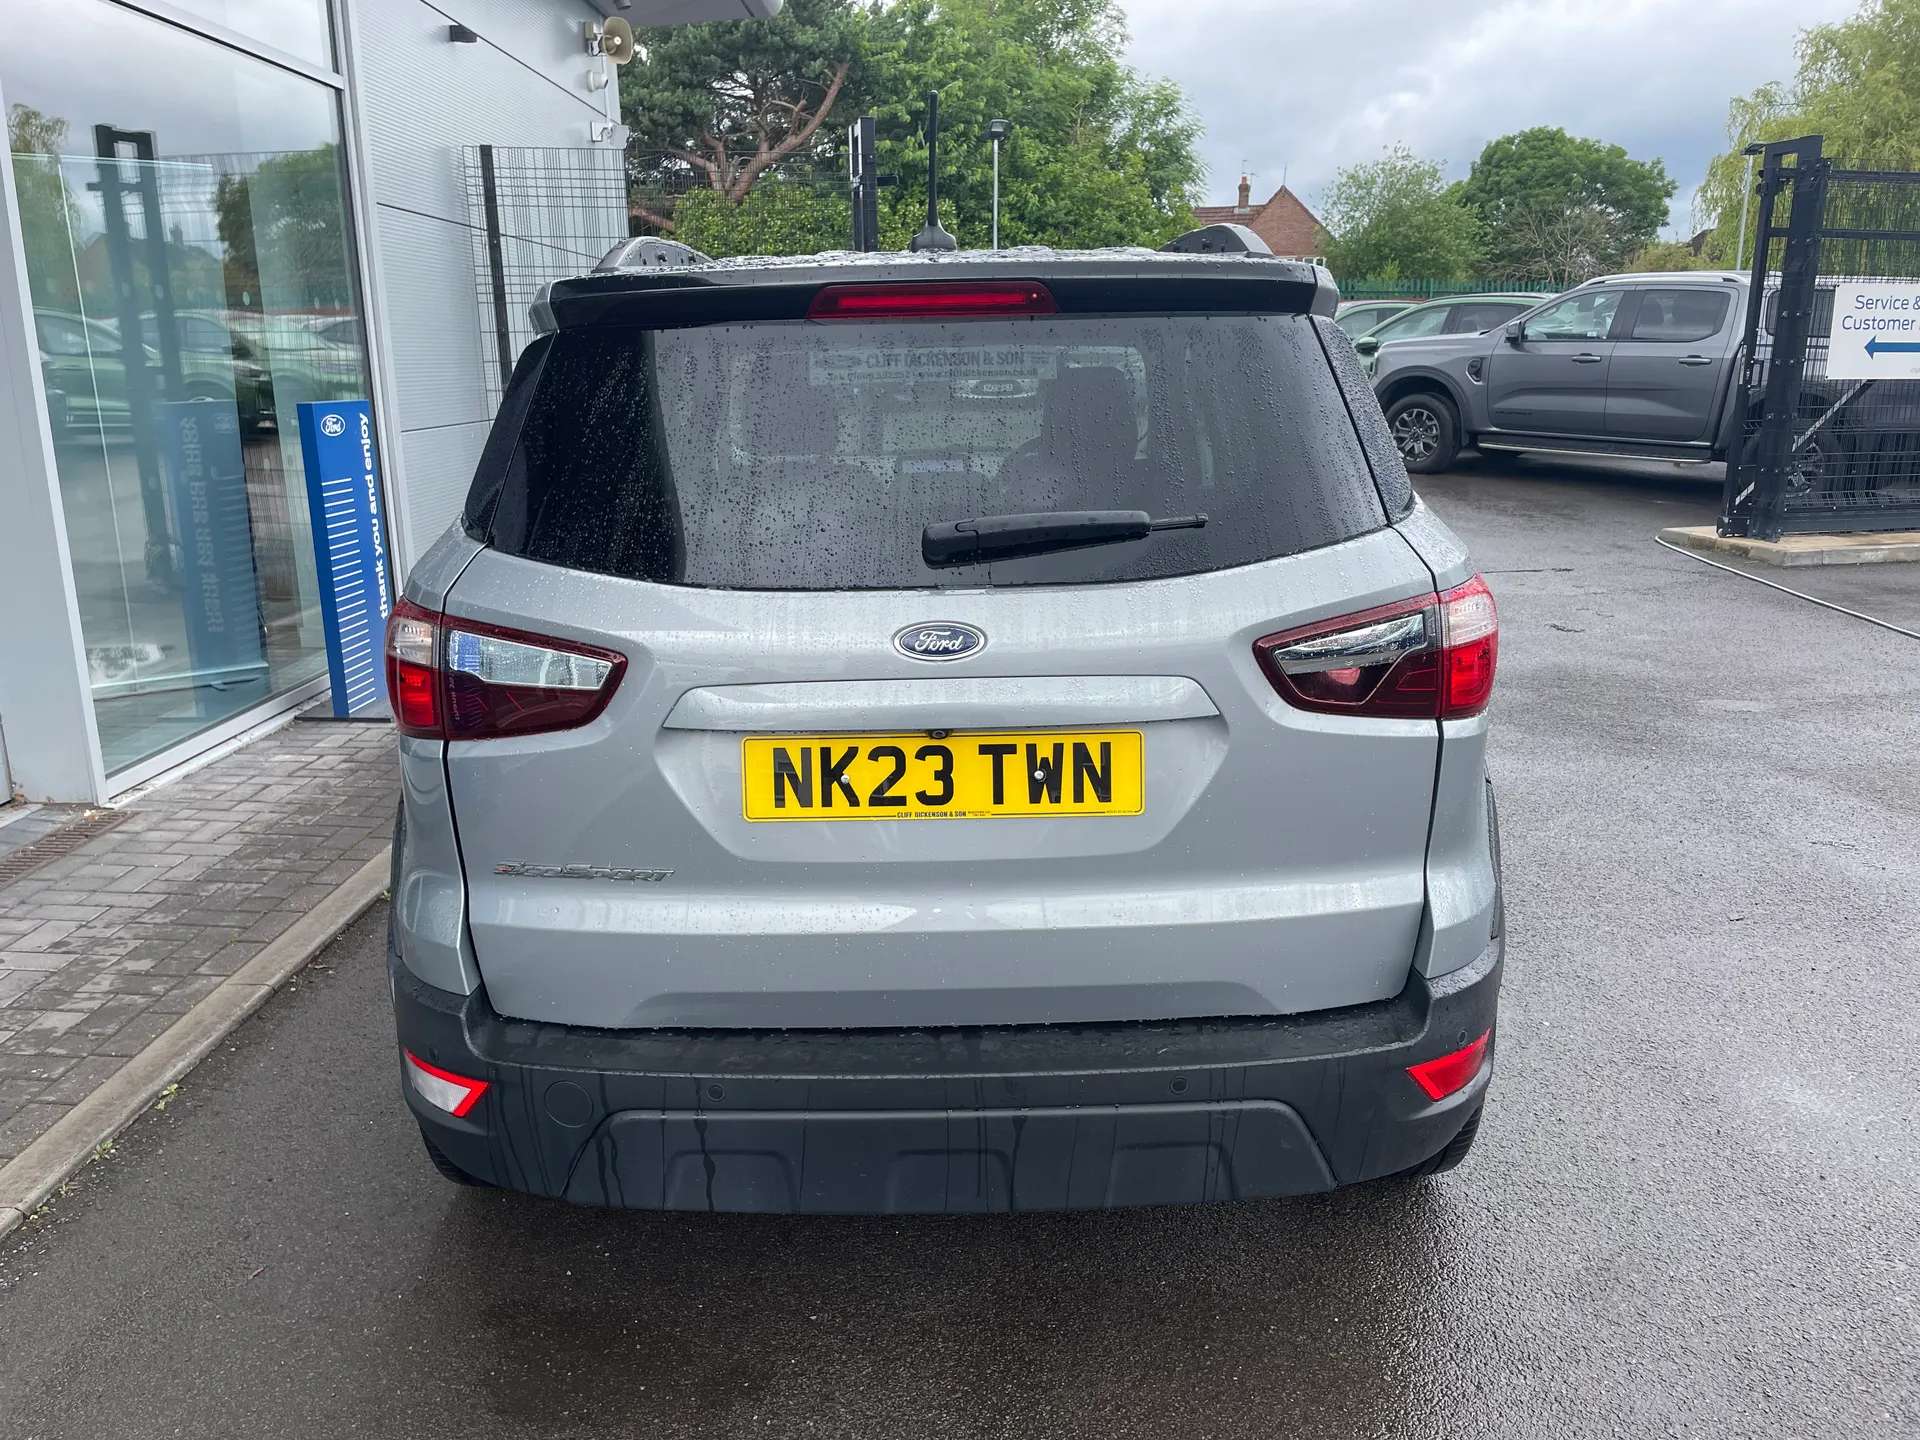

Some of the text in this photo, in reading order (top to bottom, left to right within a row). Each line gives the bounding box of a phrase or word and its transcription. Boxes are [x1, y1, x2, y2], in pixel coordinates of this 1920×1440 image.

[1855, 295, 1910, 310] Service
[1842, 315, 1916, 330] Customer
[325, 417, 342, 433] Ford
[358, 412, 389, 620] thank you and enjoy
[914, 630, 964, 652] Ford
[772, 742, 1112, 808] NK23 TWN
